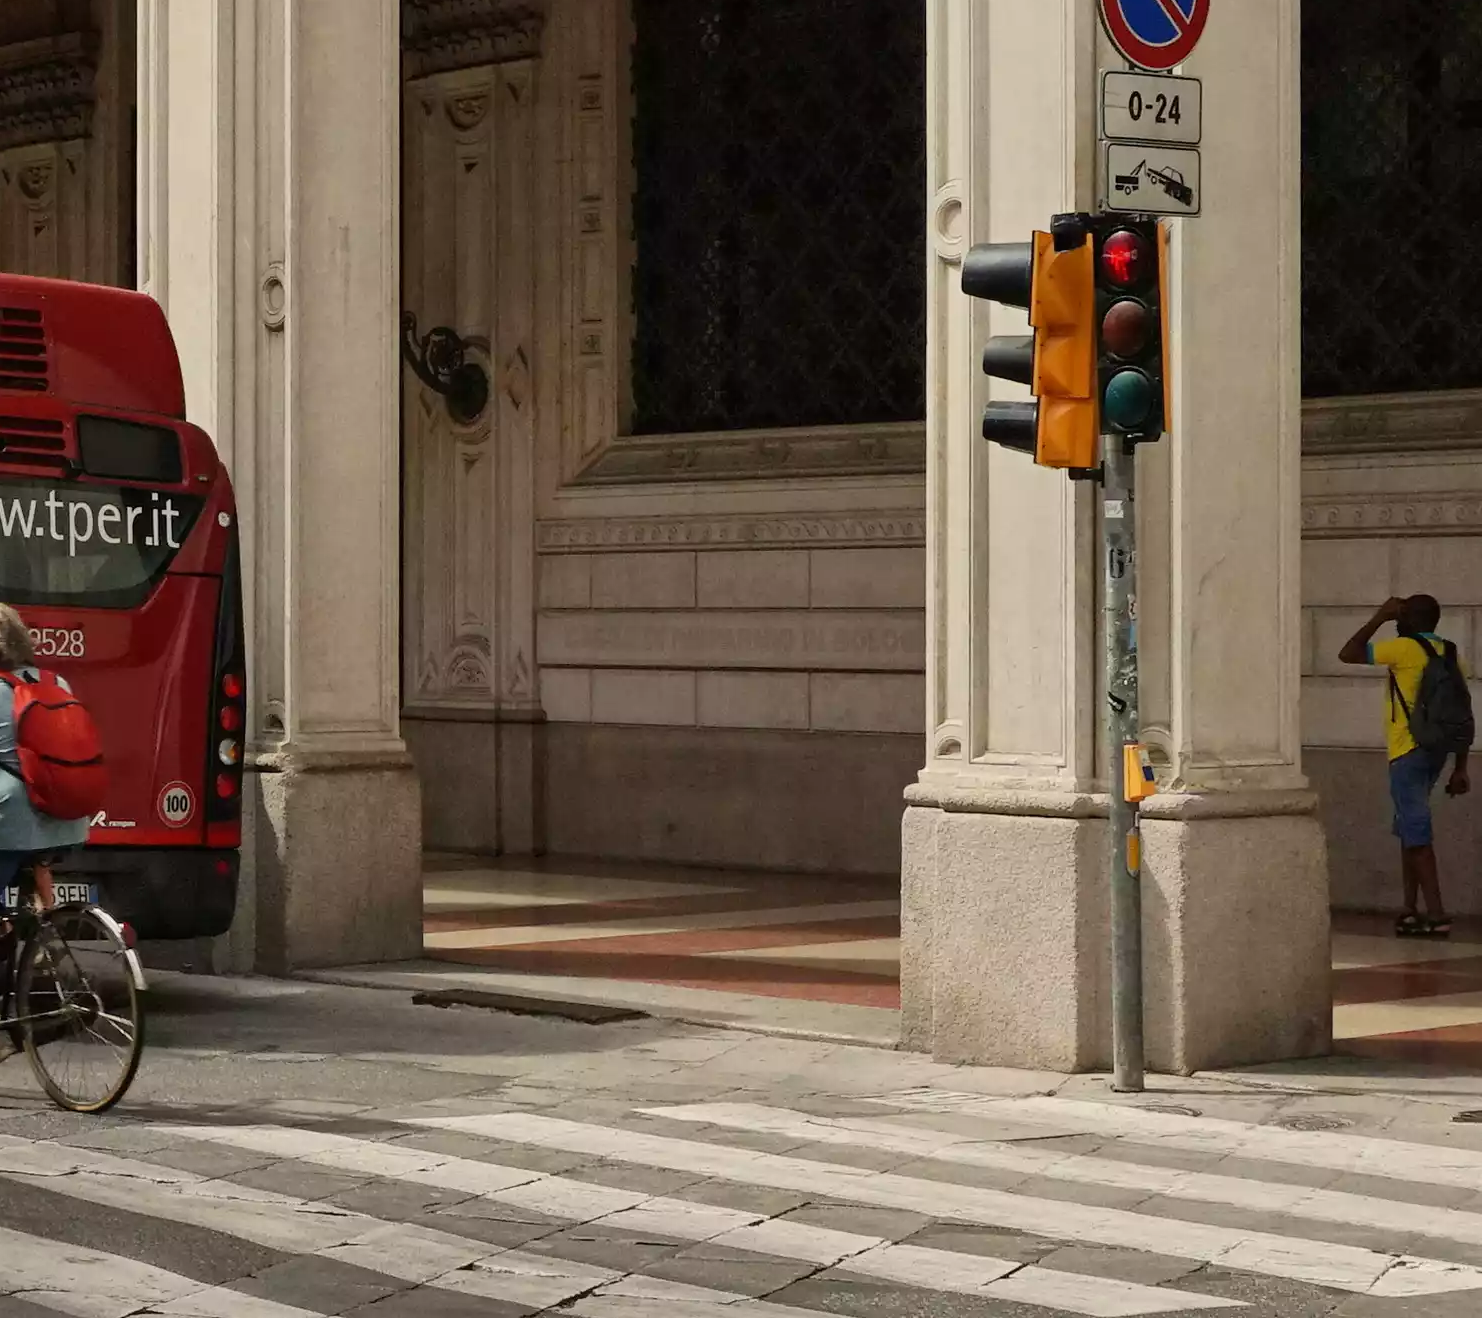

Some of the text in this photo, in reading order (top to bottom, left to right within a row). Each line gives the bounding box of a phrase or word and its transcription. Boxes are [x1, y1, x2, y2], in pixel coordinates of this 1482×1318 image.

[1128, 90, 1181, 125] 0-24
[28, 627, 85, 657] 2528
[165, 794, 189, 813] 100
